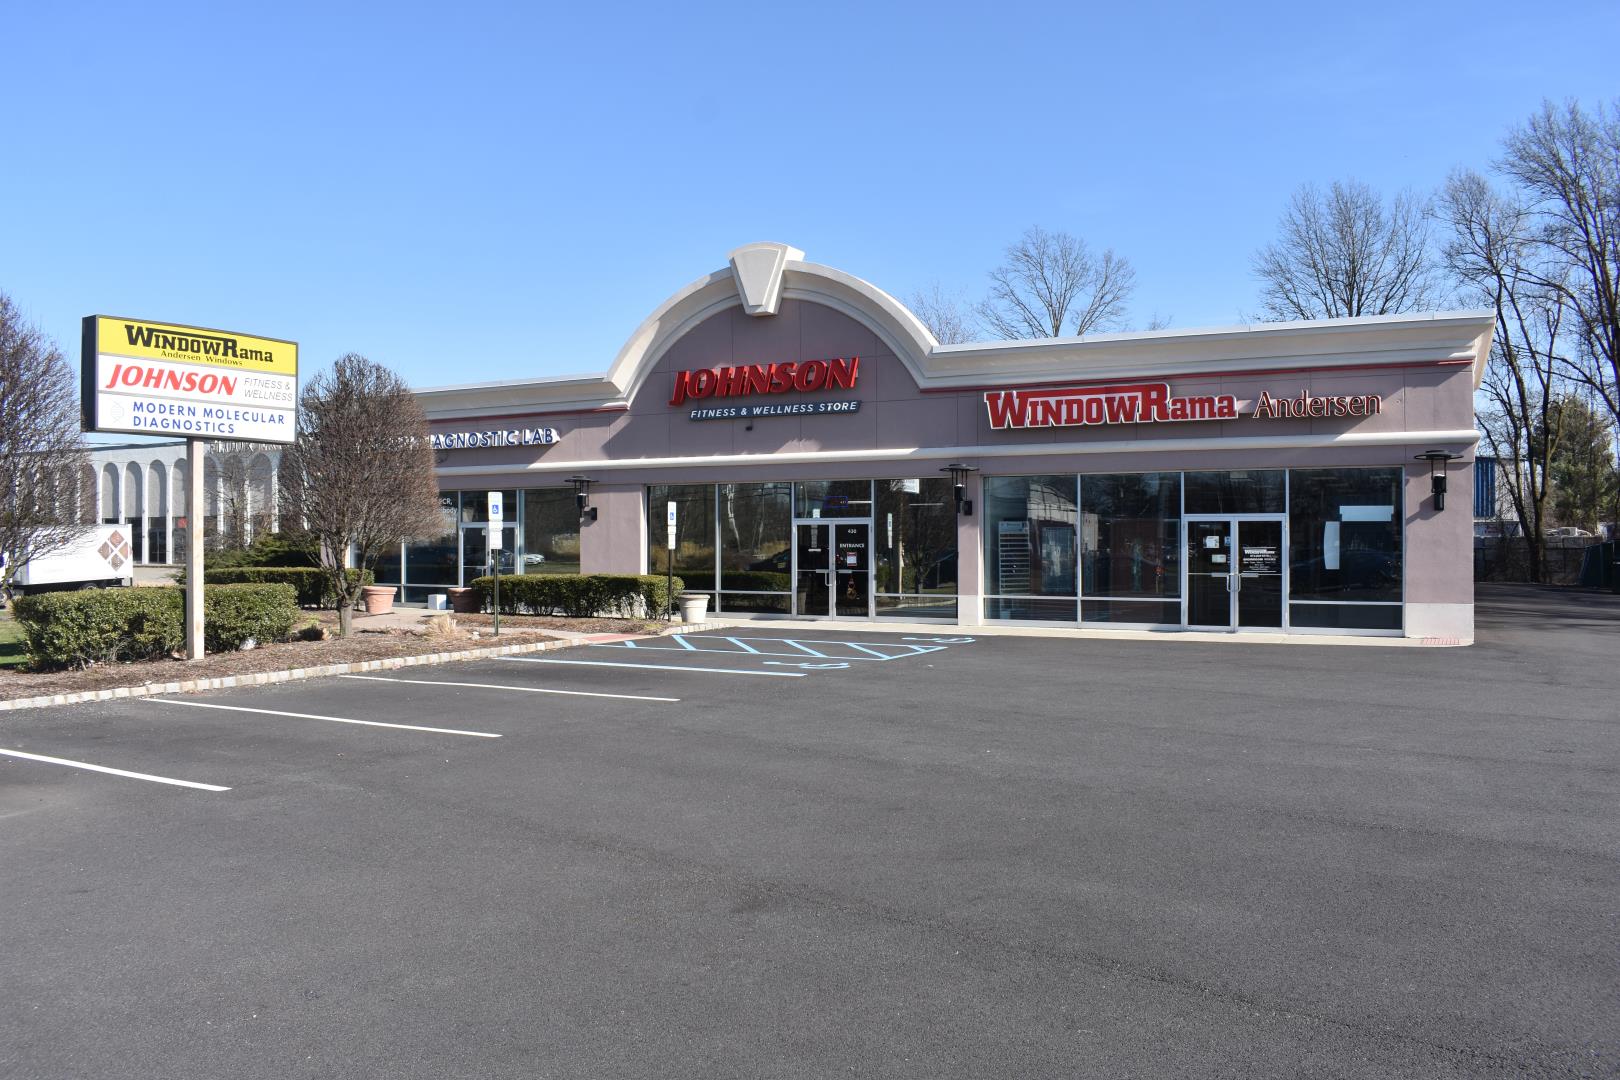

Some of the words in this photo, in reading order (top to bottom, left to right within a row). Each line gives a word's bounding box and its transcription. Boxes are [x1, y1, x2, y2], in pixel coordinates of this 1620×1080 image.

[161, 350, 201, 361] Andersen
[205, 355, 243, 367] Windows
[106, 364, 238, 396] JOHNSON
[243, 377, 283, 390] FITNESS
[284, 382, 291, 390] &
[669, 355, 860, 407] JOHNSON
[243, 389, 293, 402] WELLNESS
[1252, 390, 1382, 419] Andersen
[133, 401, 196, 417] MODERN
[203, 407, 285, 425] MOLECULAR
[691, 408, 736, 418] FITNESS
[740, 407, 747, 416] &
[752, 404, 814, 415] WELLNESS
[819, 402, 857, 412] STORE
[133, 416, 235, 434] DIAGNOSTICS
[426, 430, 519, 449] AGNOSTIC
[523, 428, 555, 445] LAB
